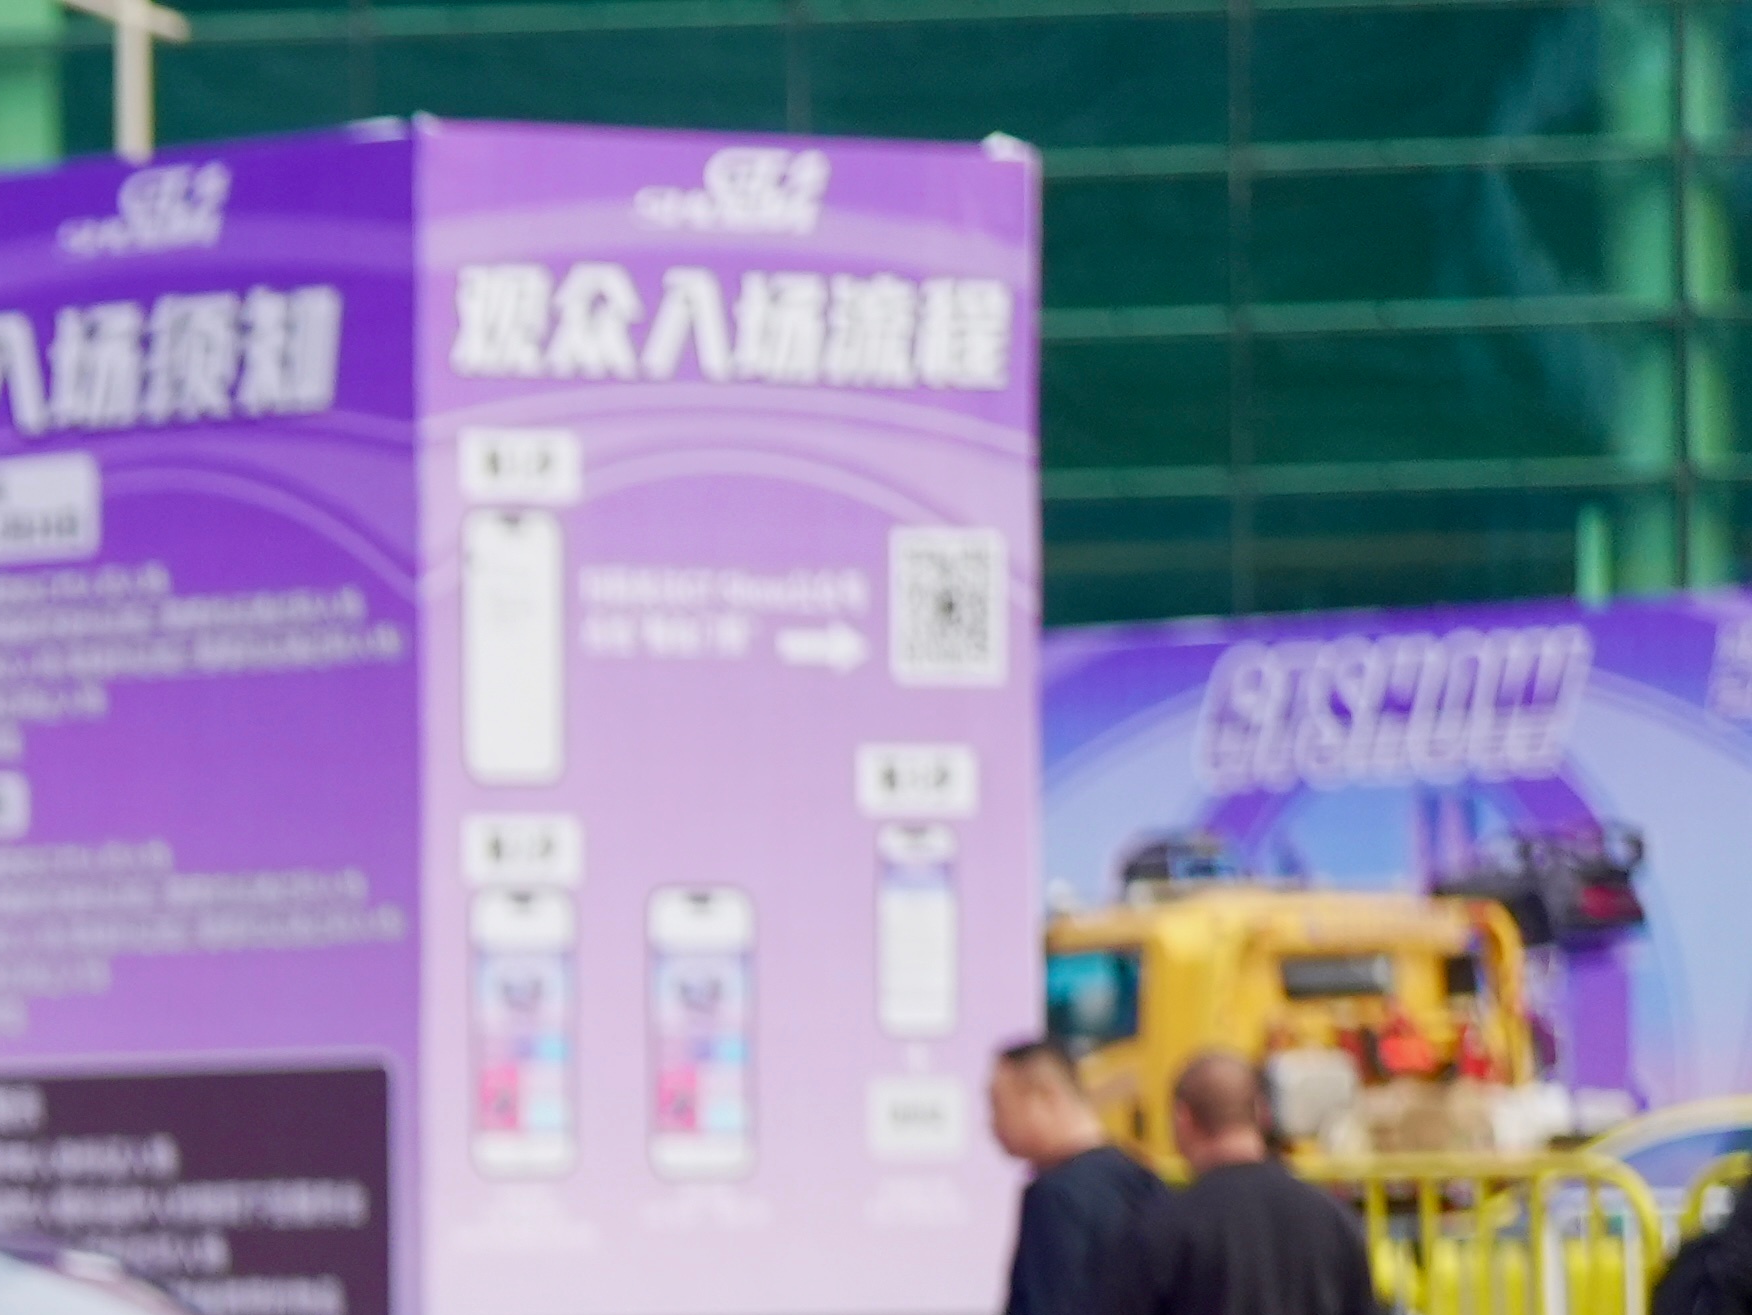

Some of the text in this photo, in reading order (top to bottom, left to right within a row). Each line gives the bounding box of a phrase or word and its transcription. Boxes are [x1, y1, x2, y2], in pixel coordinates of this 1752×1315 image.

[452, 262, 1012, 392] 观众入场流程
